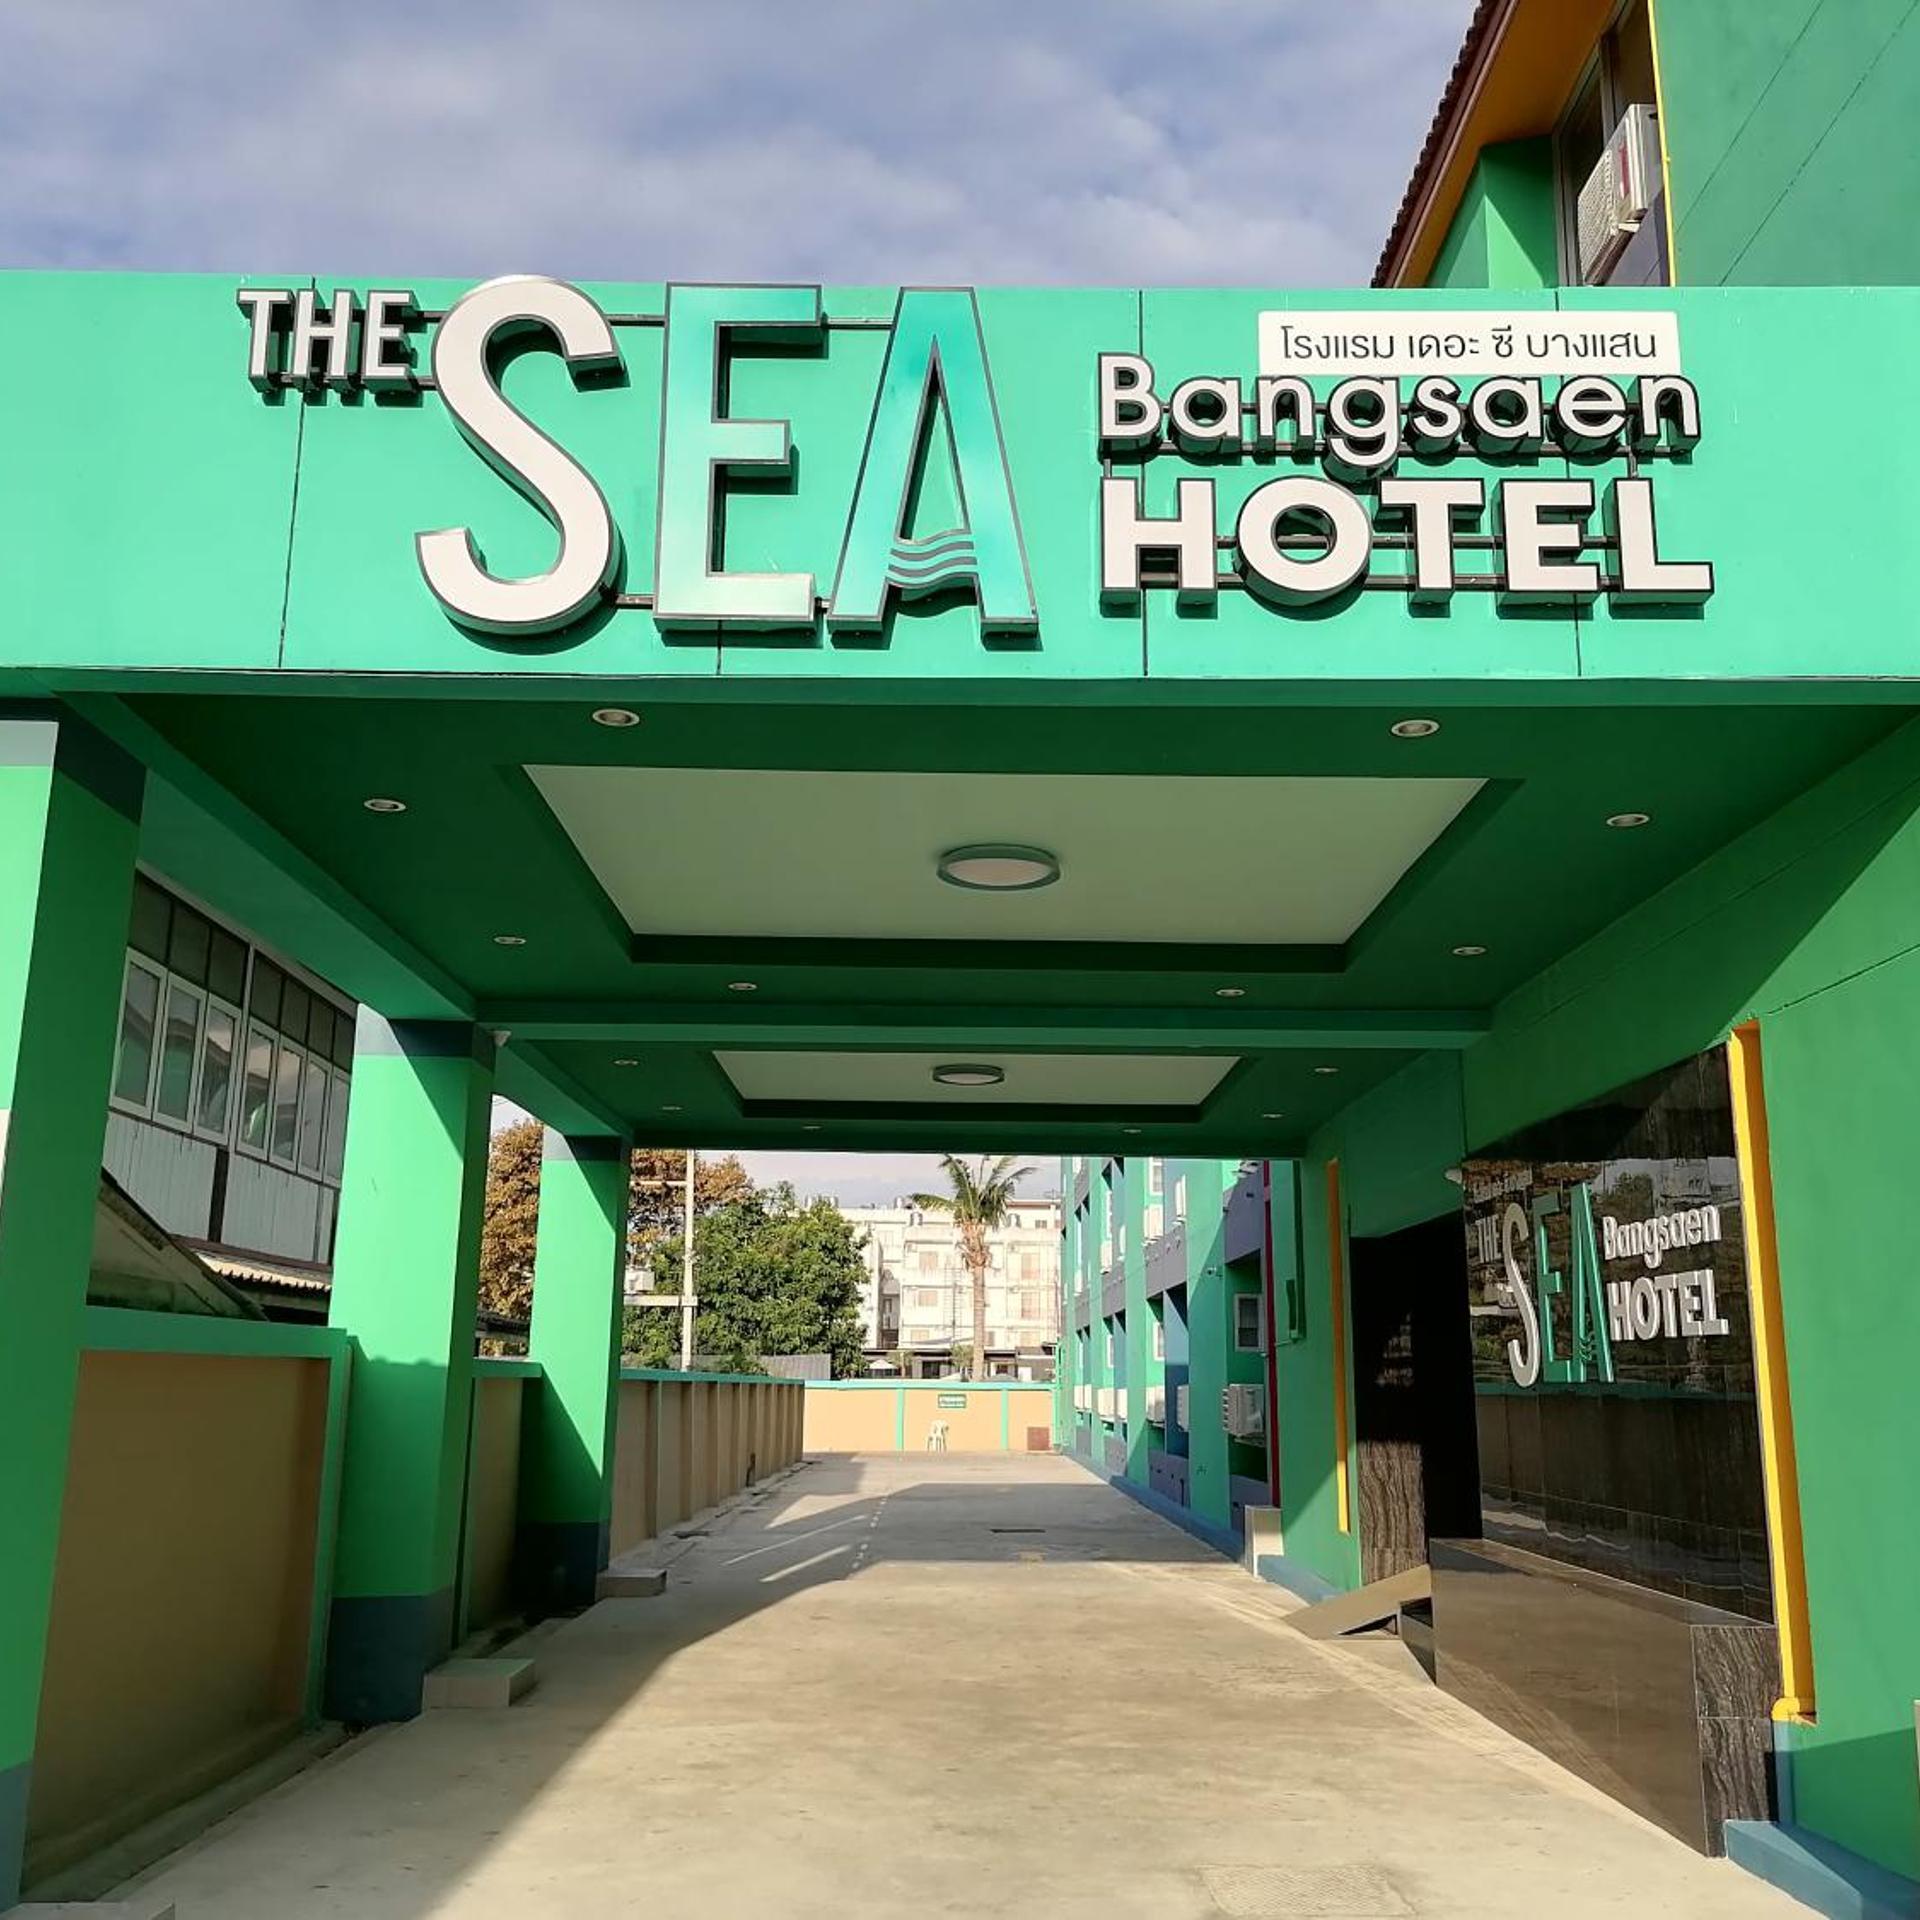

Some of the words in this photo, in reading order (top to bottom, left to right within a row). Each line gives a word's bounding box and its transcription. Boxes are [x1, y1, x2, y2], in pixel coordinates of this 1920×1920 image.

[1281, 325, 1395, 359] โรงแรม
[1408, 332, 1480, 358] เดอะ
[1491, 325, 1514, 358] ซี
[1526, 332, 1658, 358] บางแสน
[237, 290, 413, 377] THE
[415, 275, 1038, 634] SEA
[1098, 353, 1699, 467] Bangsaen
[1101, 476, 1714, 592] HOTEL
[1475, 1214, 1502, 1263] THE
[1503, 1182, 1614, 1387] SEA
[1602, 1205, 1722, 1268] Bangsaen
[1606, 1269, 1729, 1341] HOTEL
